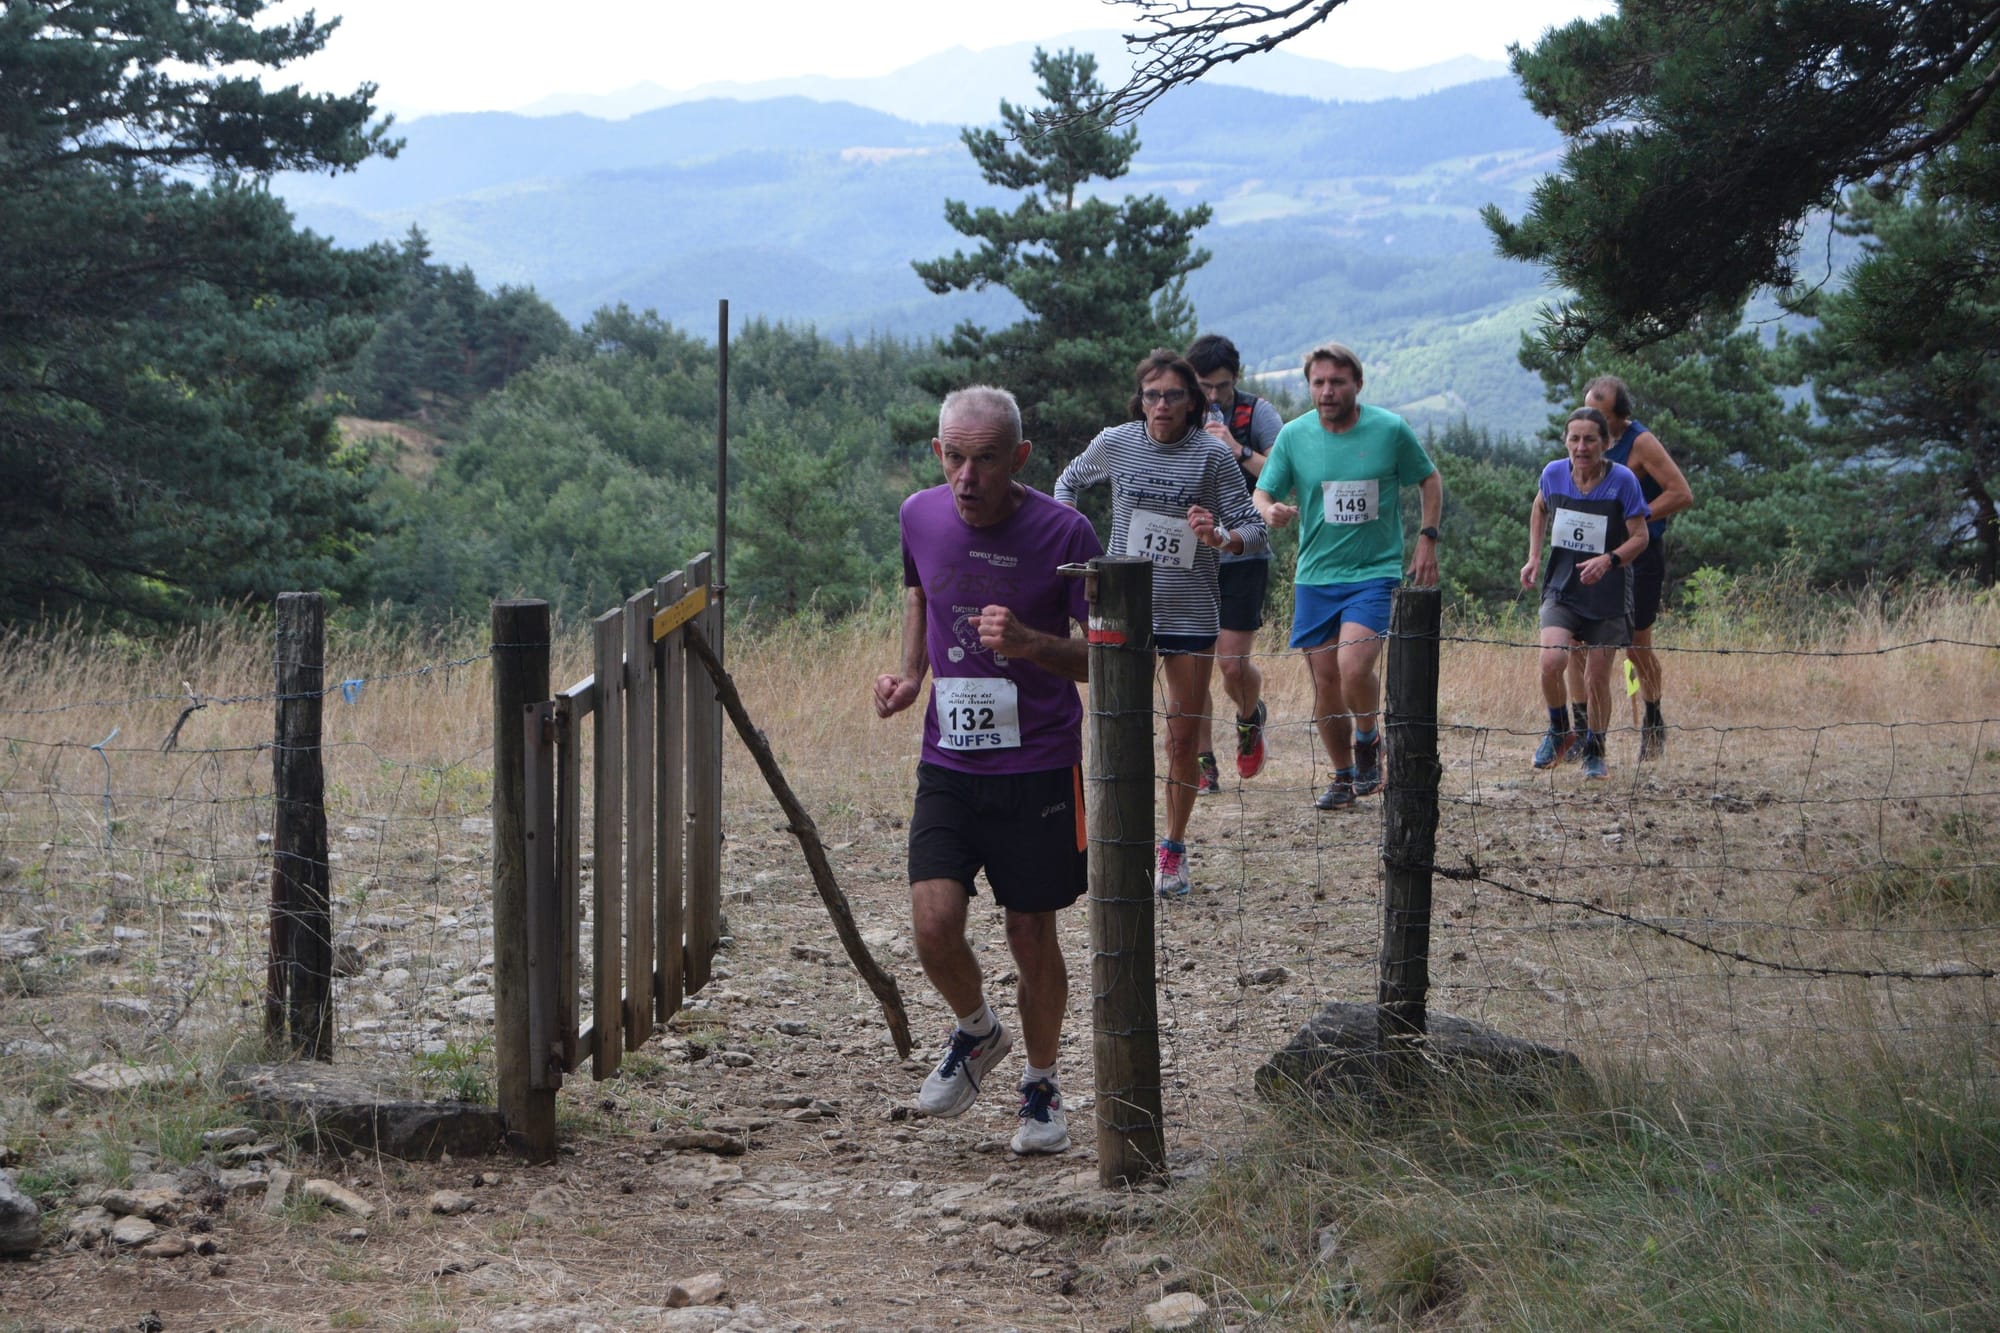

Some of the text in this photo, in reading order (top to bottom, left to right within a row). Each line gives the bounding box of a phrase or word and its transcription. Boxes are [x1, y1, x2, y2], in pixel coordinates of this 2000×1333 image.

[1336, 498, 1366, 512] 149
[1334, 513, 1368, 521] TUFF'S
[1574, 528, 1584, 541] 6
[1144, 533, 1181, 554] 135
[1561, 539, 1595, 551] TUFF'S
[949, 706, 995, 731] 132
[948, 733, 1001, 747] TUFF'S
